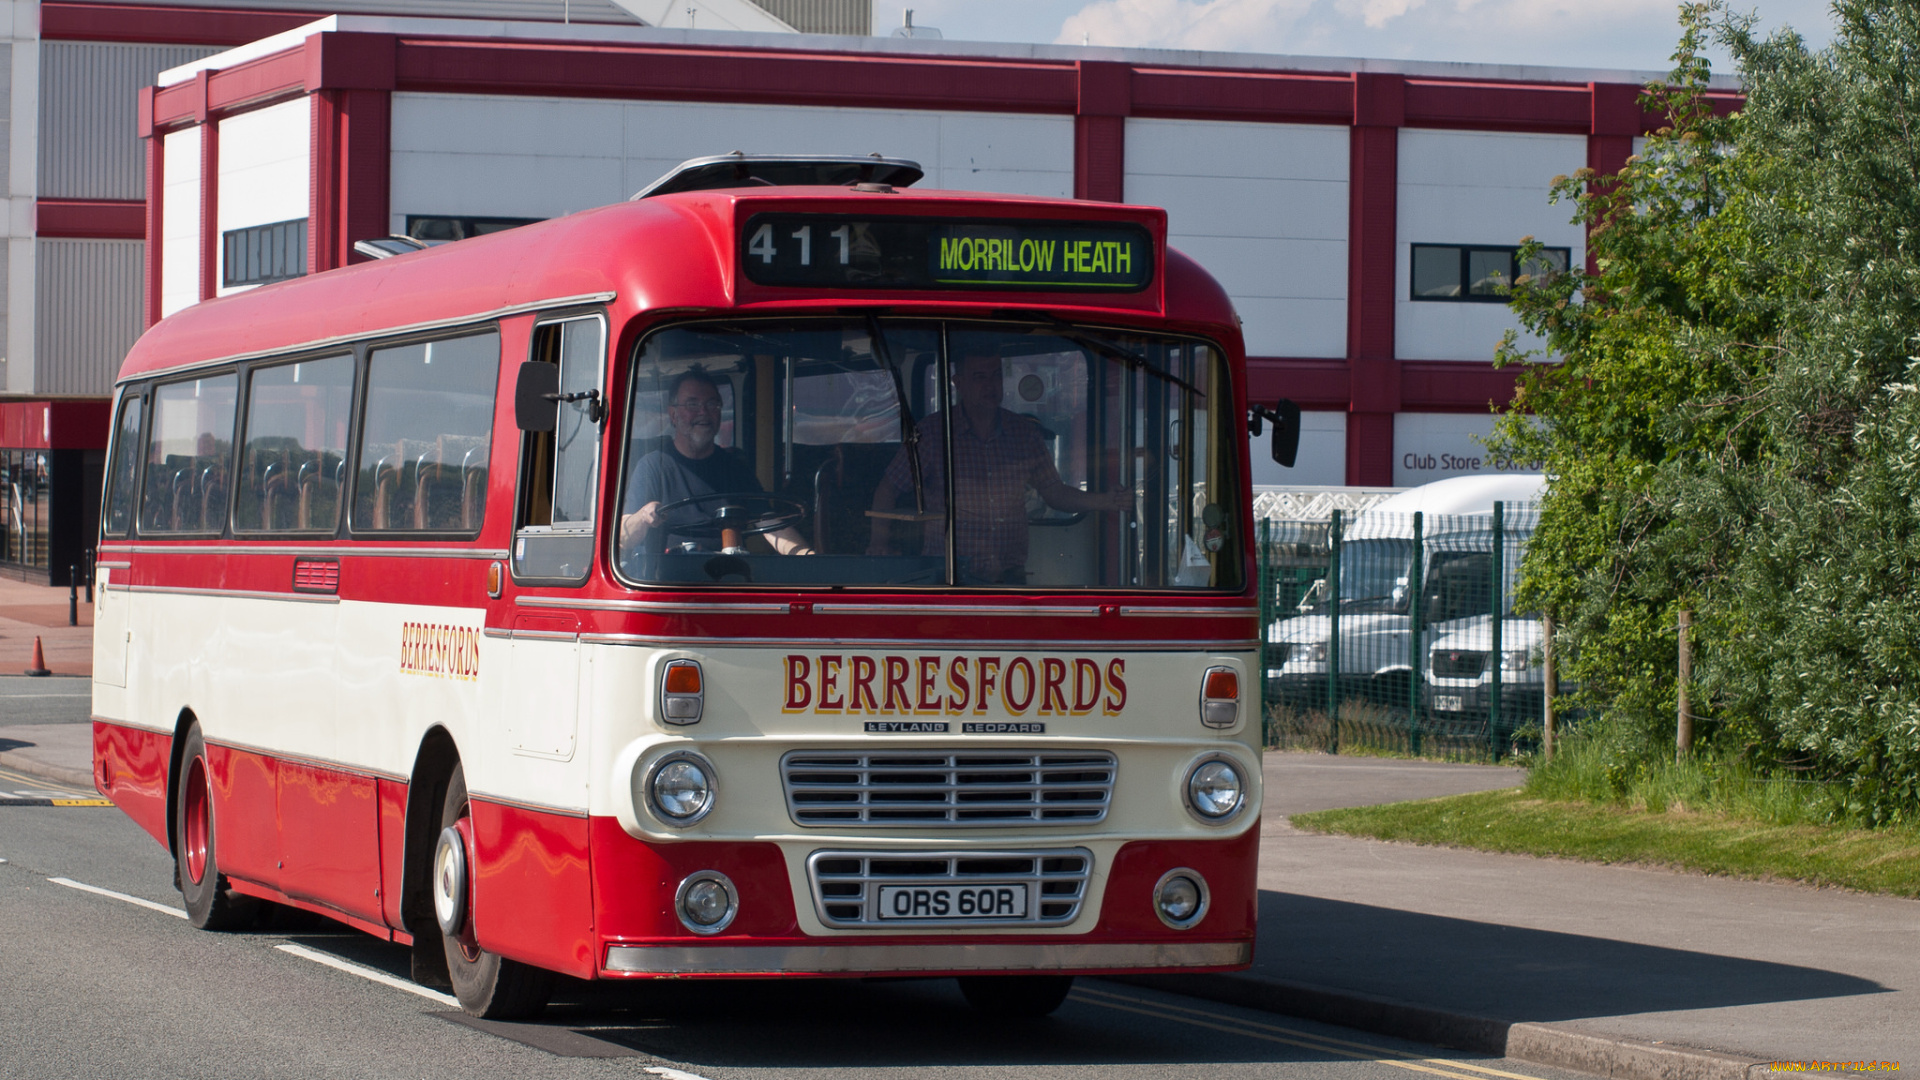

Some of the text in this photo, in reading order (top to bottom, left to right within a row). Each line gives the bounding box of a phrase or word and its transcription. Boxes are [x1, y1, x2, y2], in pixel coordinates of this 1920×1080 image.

[939, 236, 1132, 274] MORRILOW HEATH
[1403, 453, 1437, 470] Club
[1441, 453, 1480, 470] Store
[400, 621, 480, 682] BERRESFORDS
[781, 654, 1128, 717] BERRESFORDS
[867, 722, 1042, 733] LEYLAND LEOPARD
[893, 888, 1014, 916] ORS 60R
